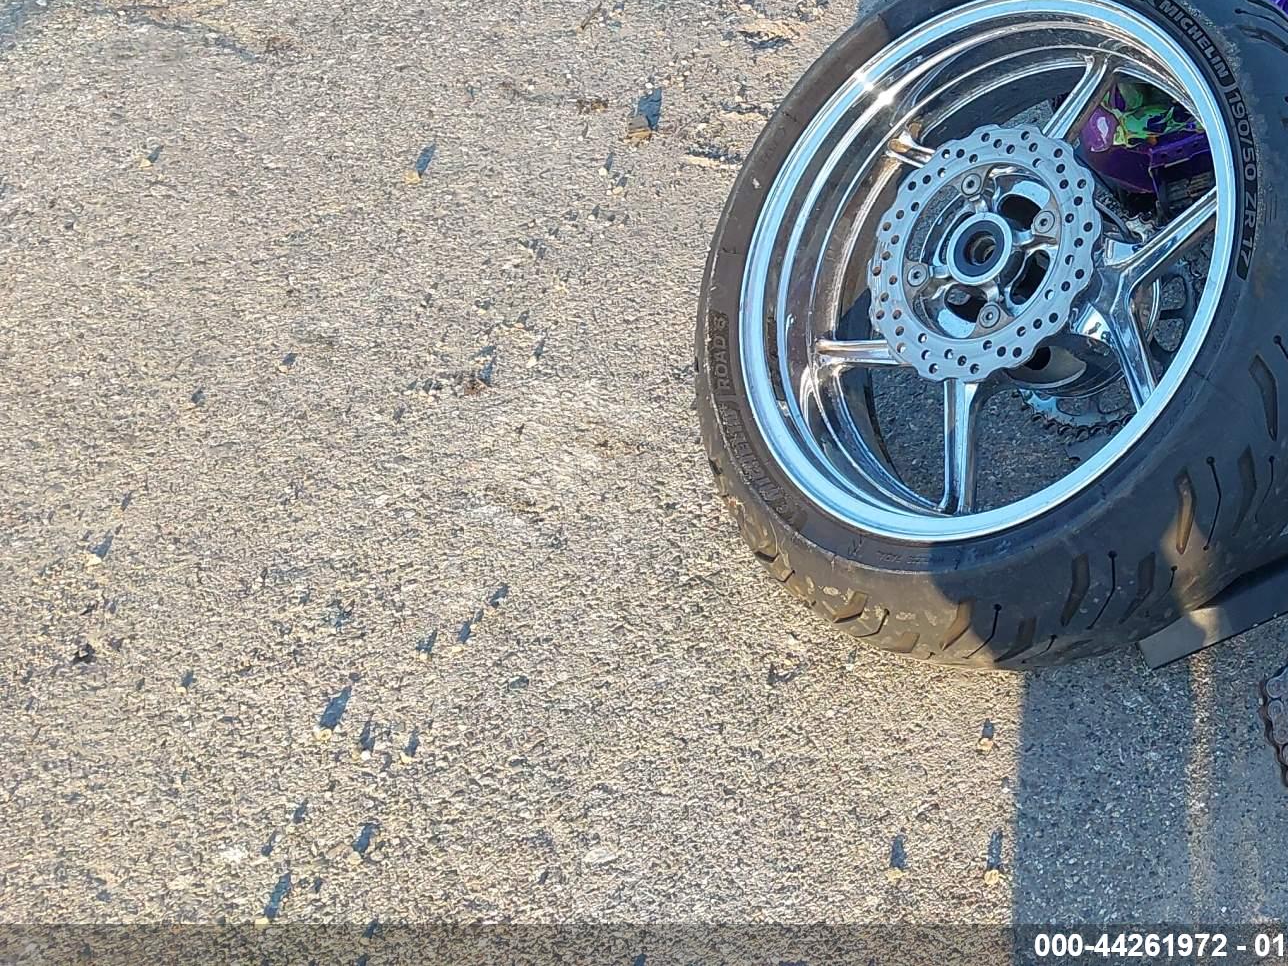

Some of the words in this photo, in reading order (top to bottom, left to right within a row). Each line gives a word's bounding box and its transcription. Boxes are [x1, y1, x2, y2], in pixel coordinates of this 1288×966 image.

[1158, 0, 1231, 81] MICHELIN
[1225, 87, 1257, 184] 190/50
[1244, 191, 1257, 229] ZR
[1241, 236, 1254, 267] 17
[713, 333, 731, 391] ROAD
